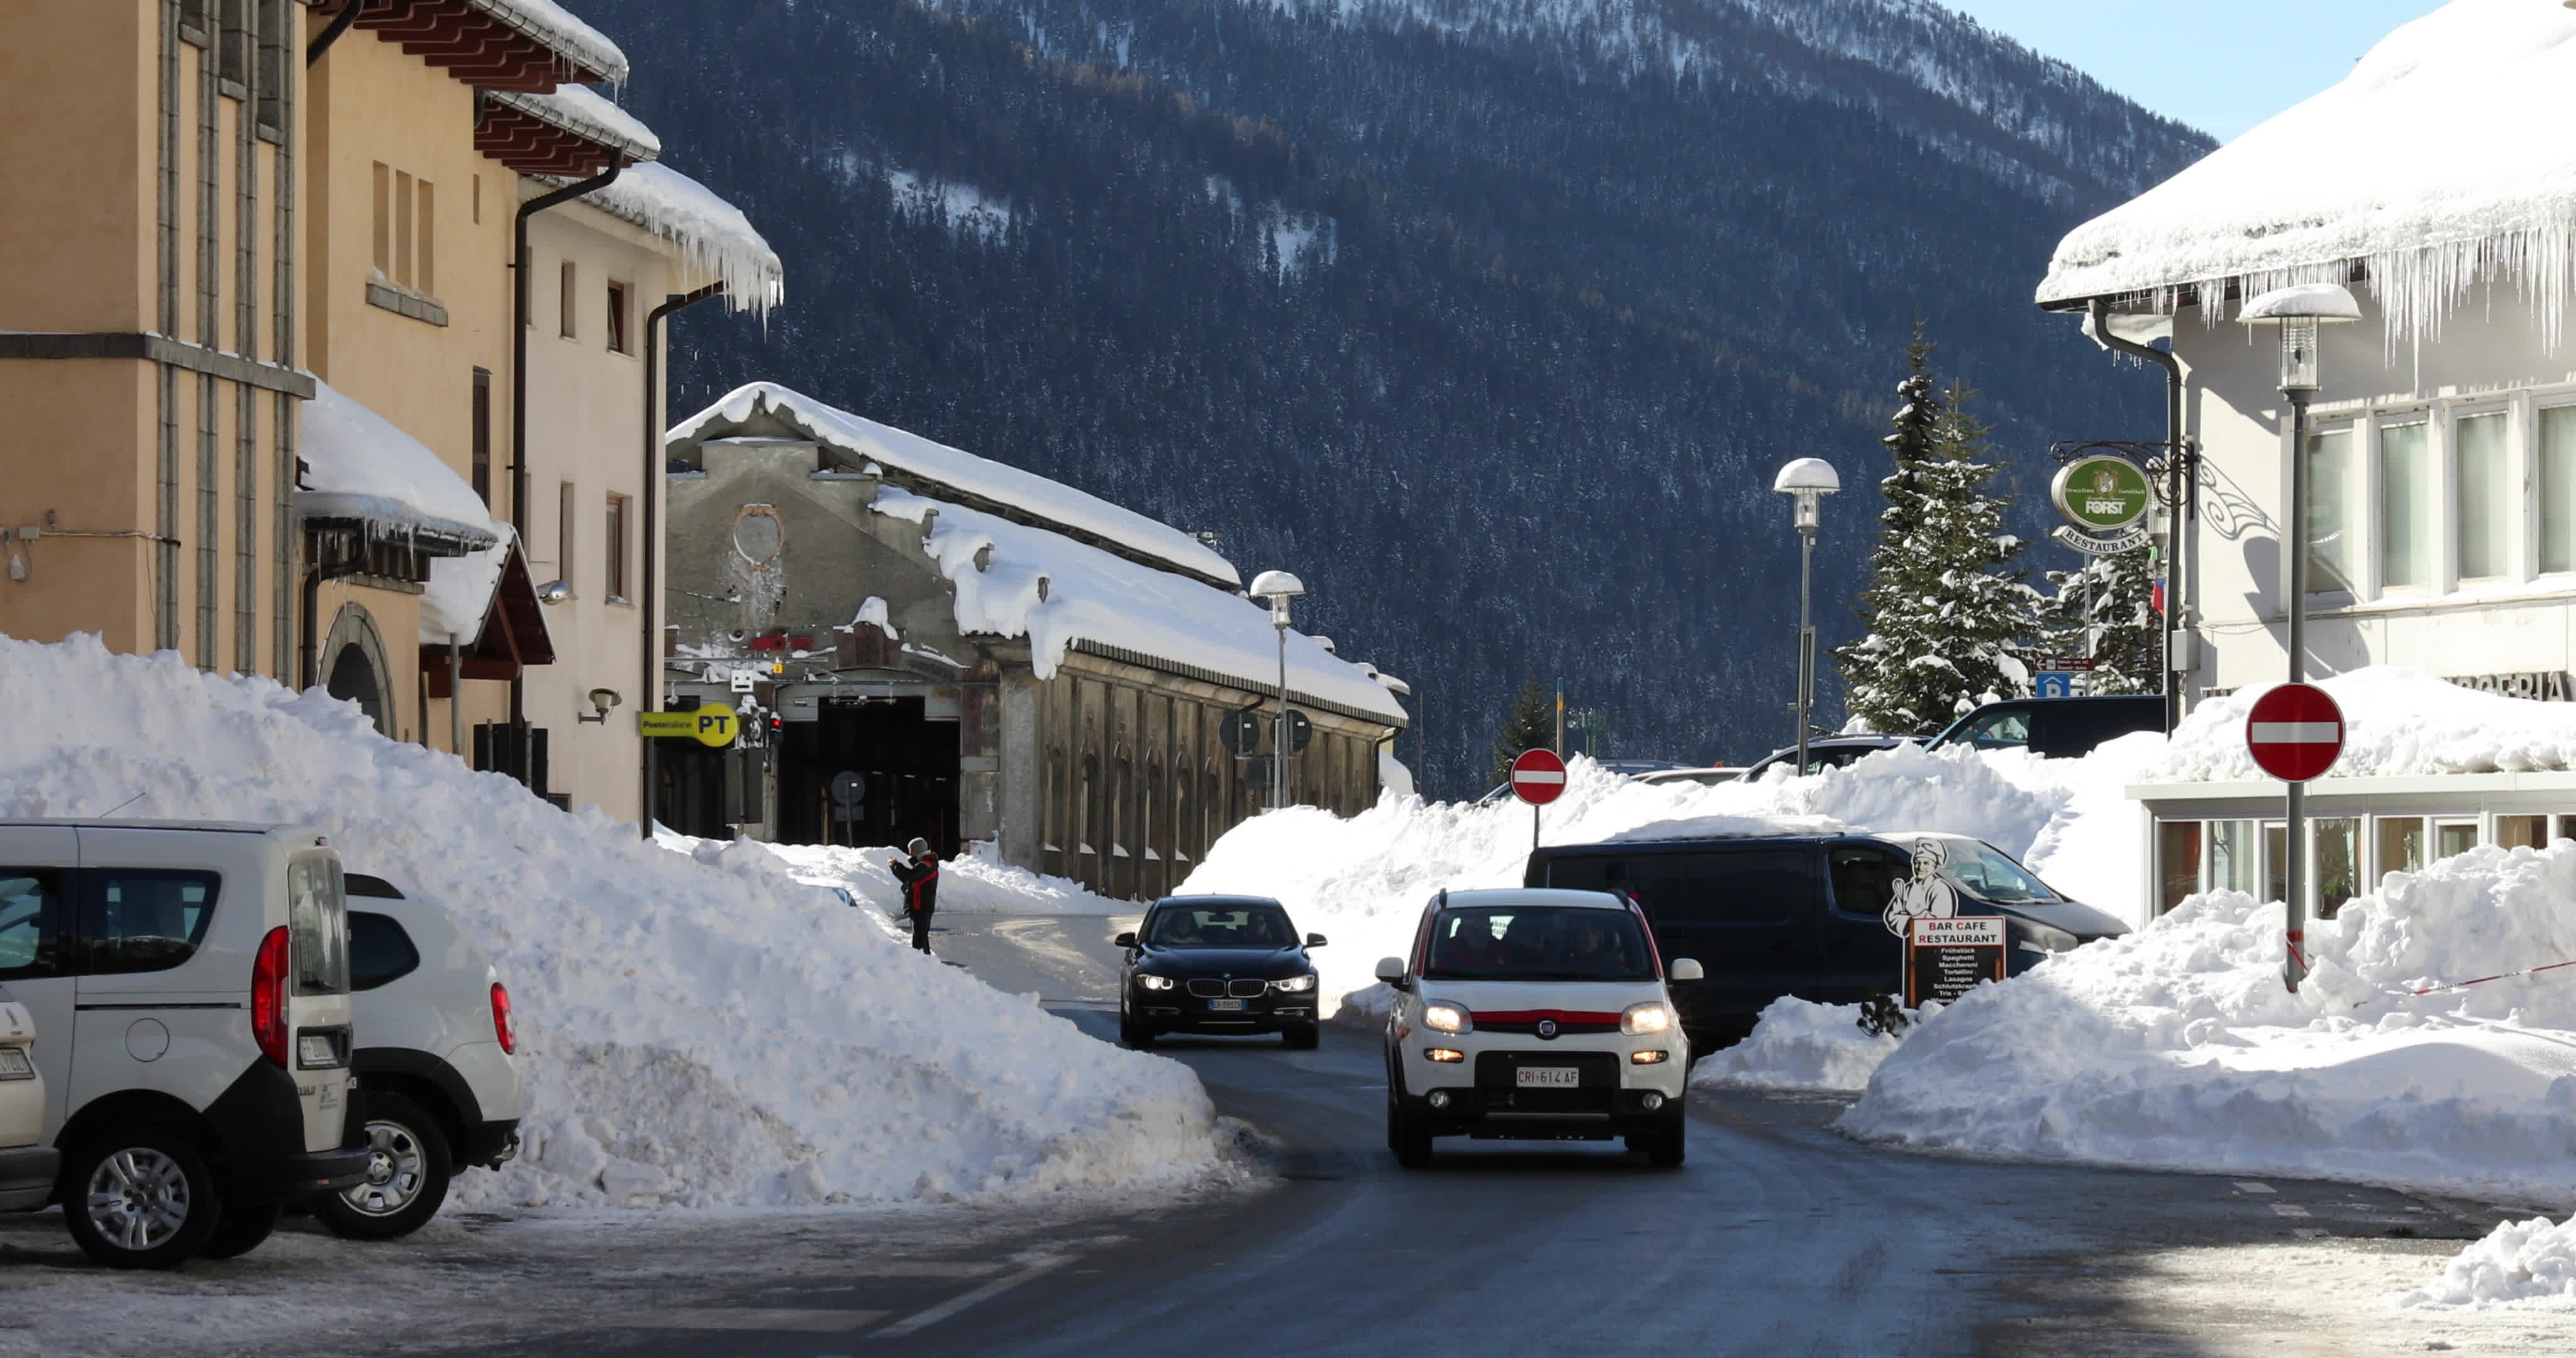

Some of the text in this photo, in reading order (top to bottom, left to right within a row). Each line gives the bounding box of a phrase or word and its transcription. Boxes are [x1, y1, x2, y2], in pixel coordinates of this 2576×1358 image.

[2085, 500, 2126, 514] FORST
[2067, 529, 2143, 552] RESTAURANT
[699, 716, 730, 734] PT
[1929, 922, 1987, 930] BAR CAFE
[1919, 935, 1997, 943] RESTAURANT
[1565, 1071, 1577, 1083] AF
